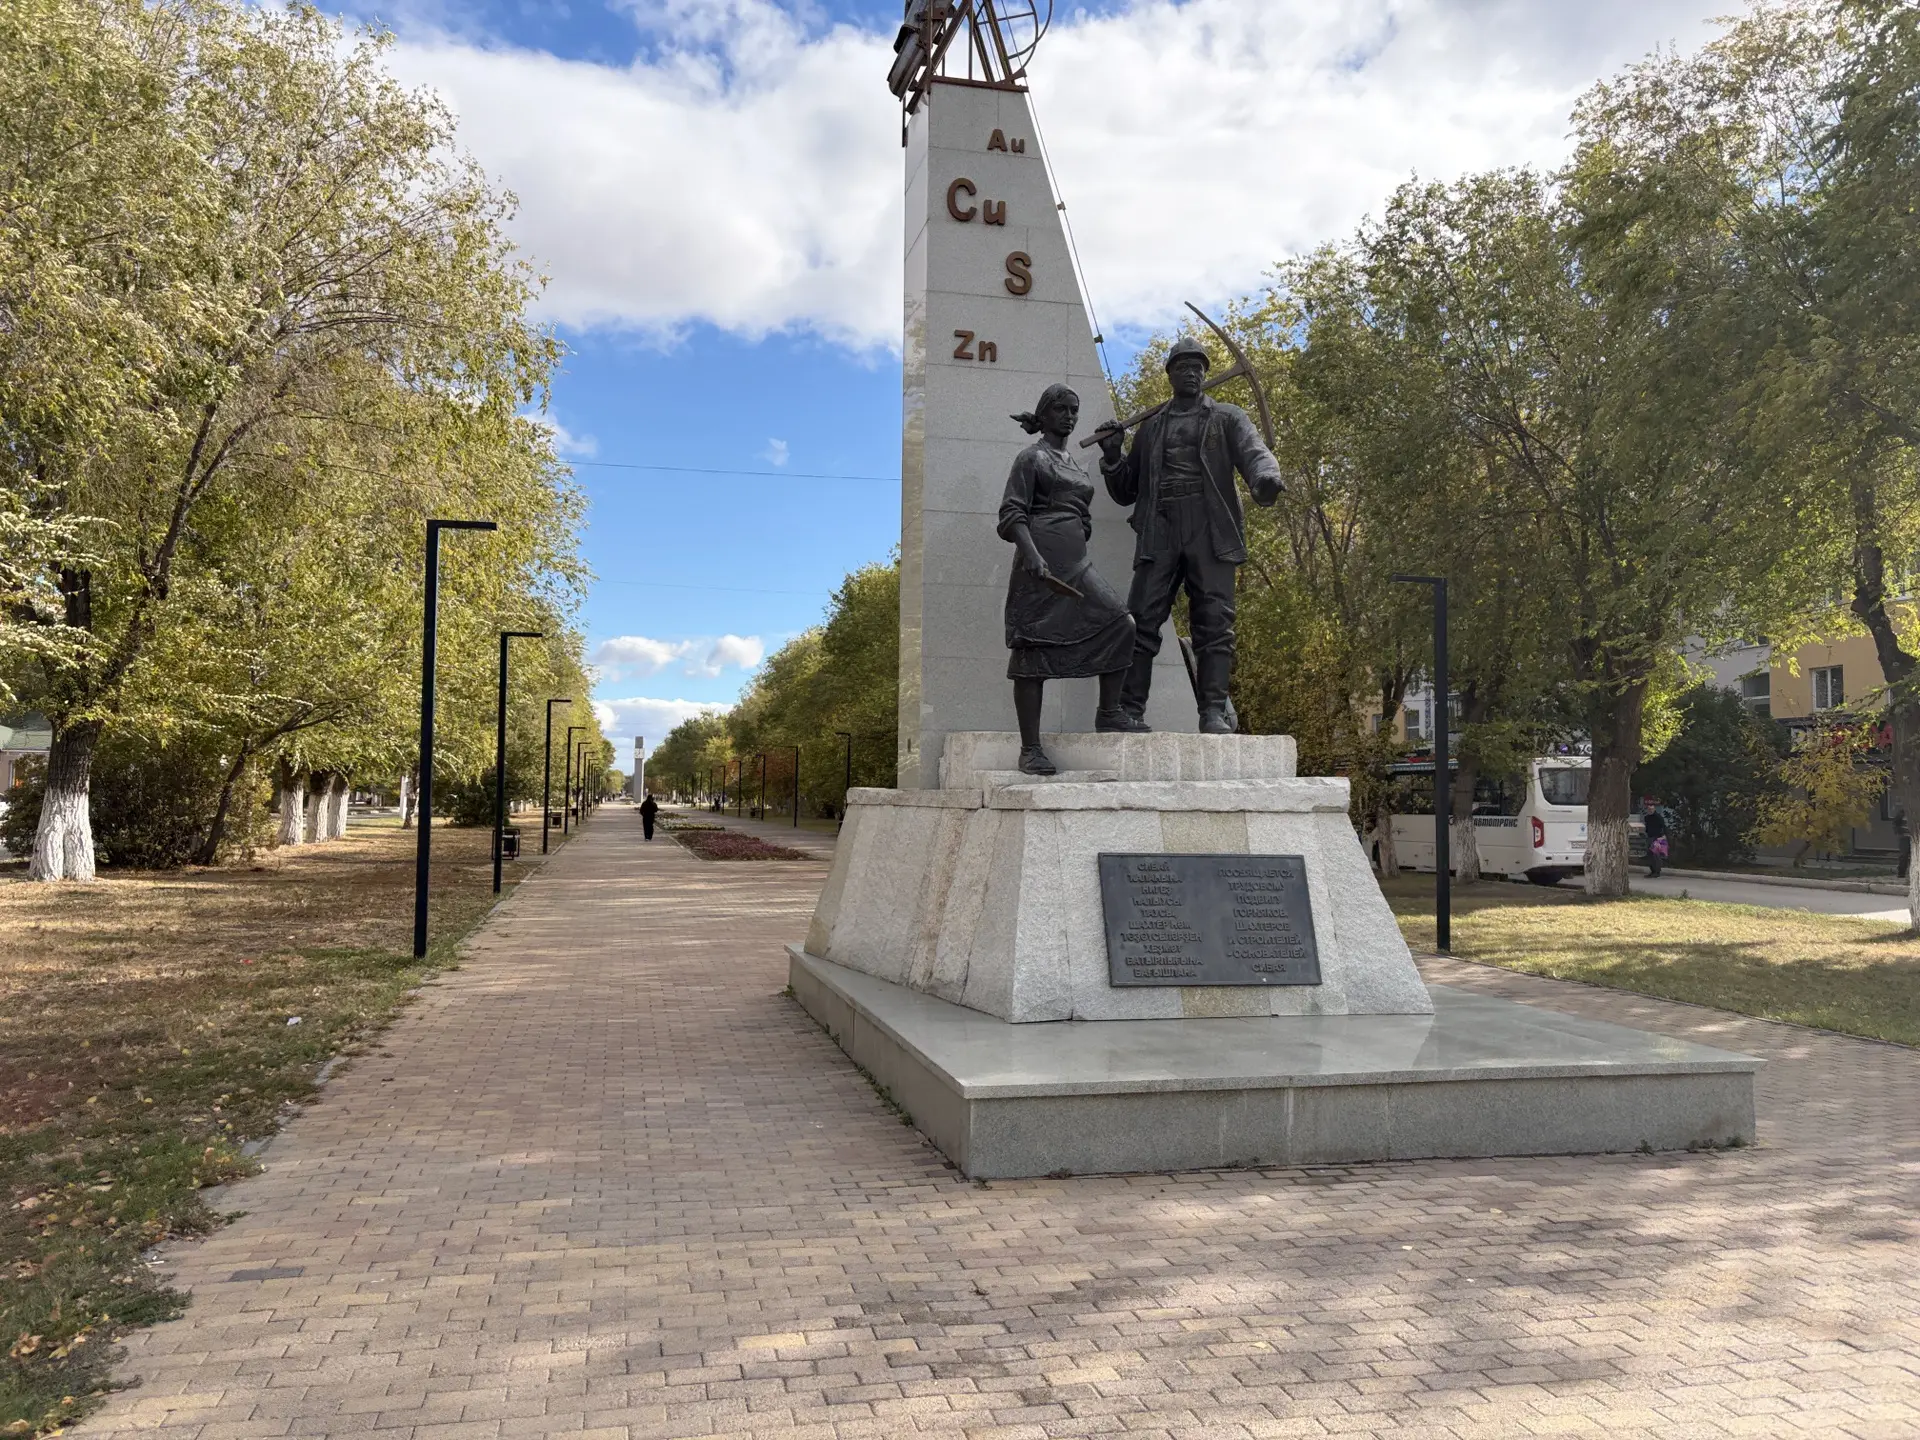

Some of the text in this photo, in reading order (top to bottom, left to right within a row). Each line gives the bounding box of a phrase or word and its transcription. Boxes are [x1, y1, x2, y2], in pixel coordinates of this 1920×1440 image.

[987, 128, 1025, 154] Au
[946, 177, 1007, 226] Cu
[1004, 251, 1033, 295] S
[953, 329, 998, 362] Zn
